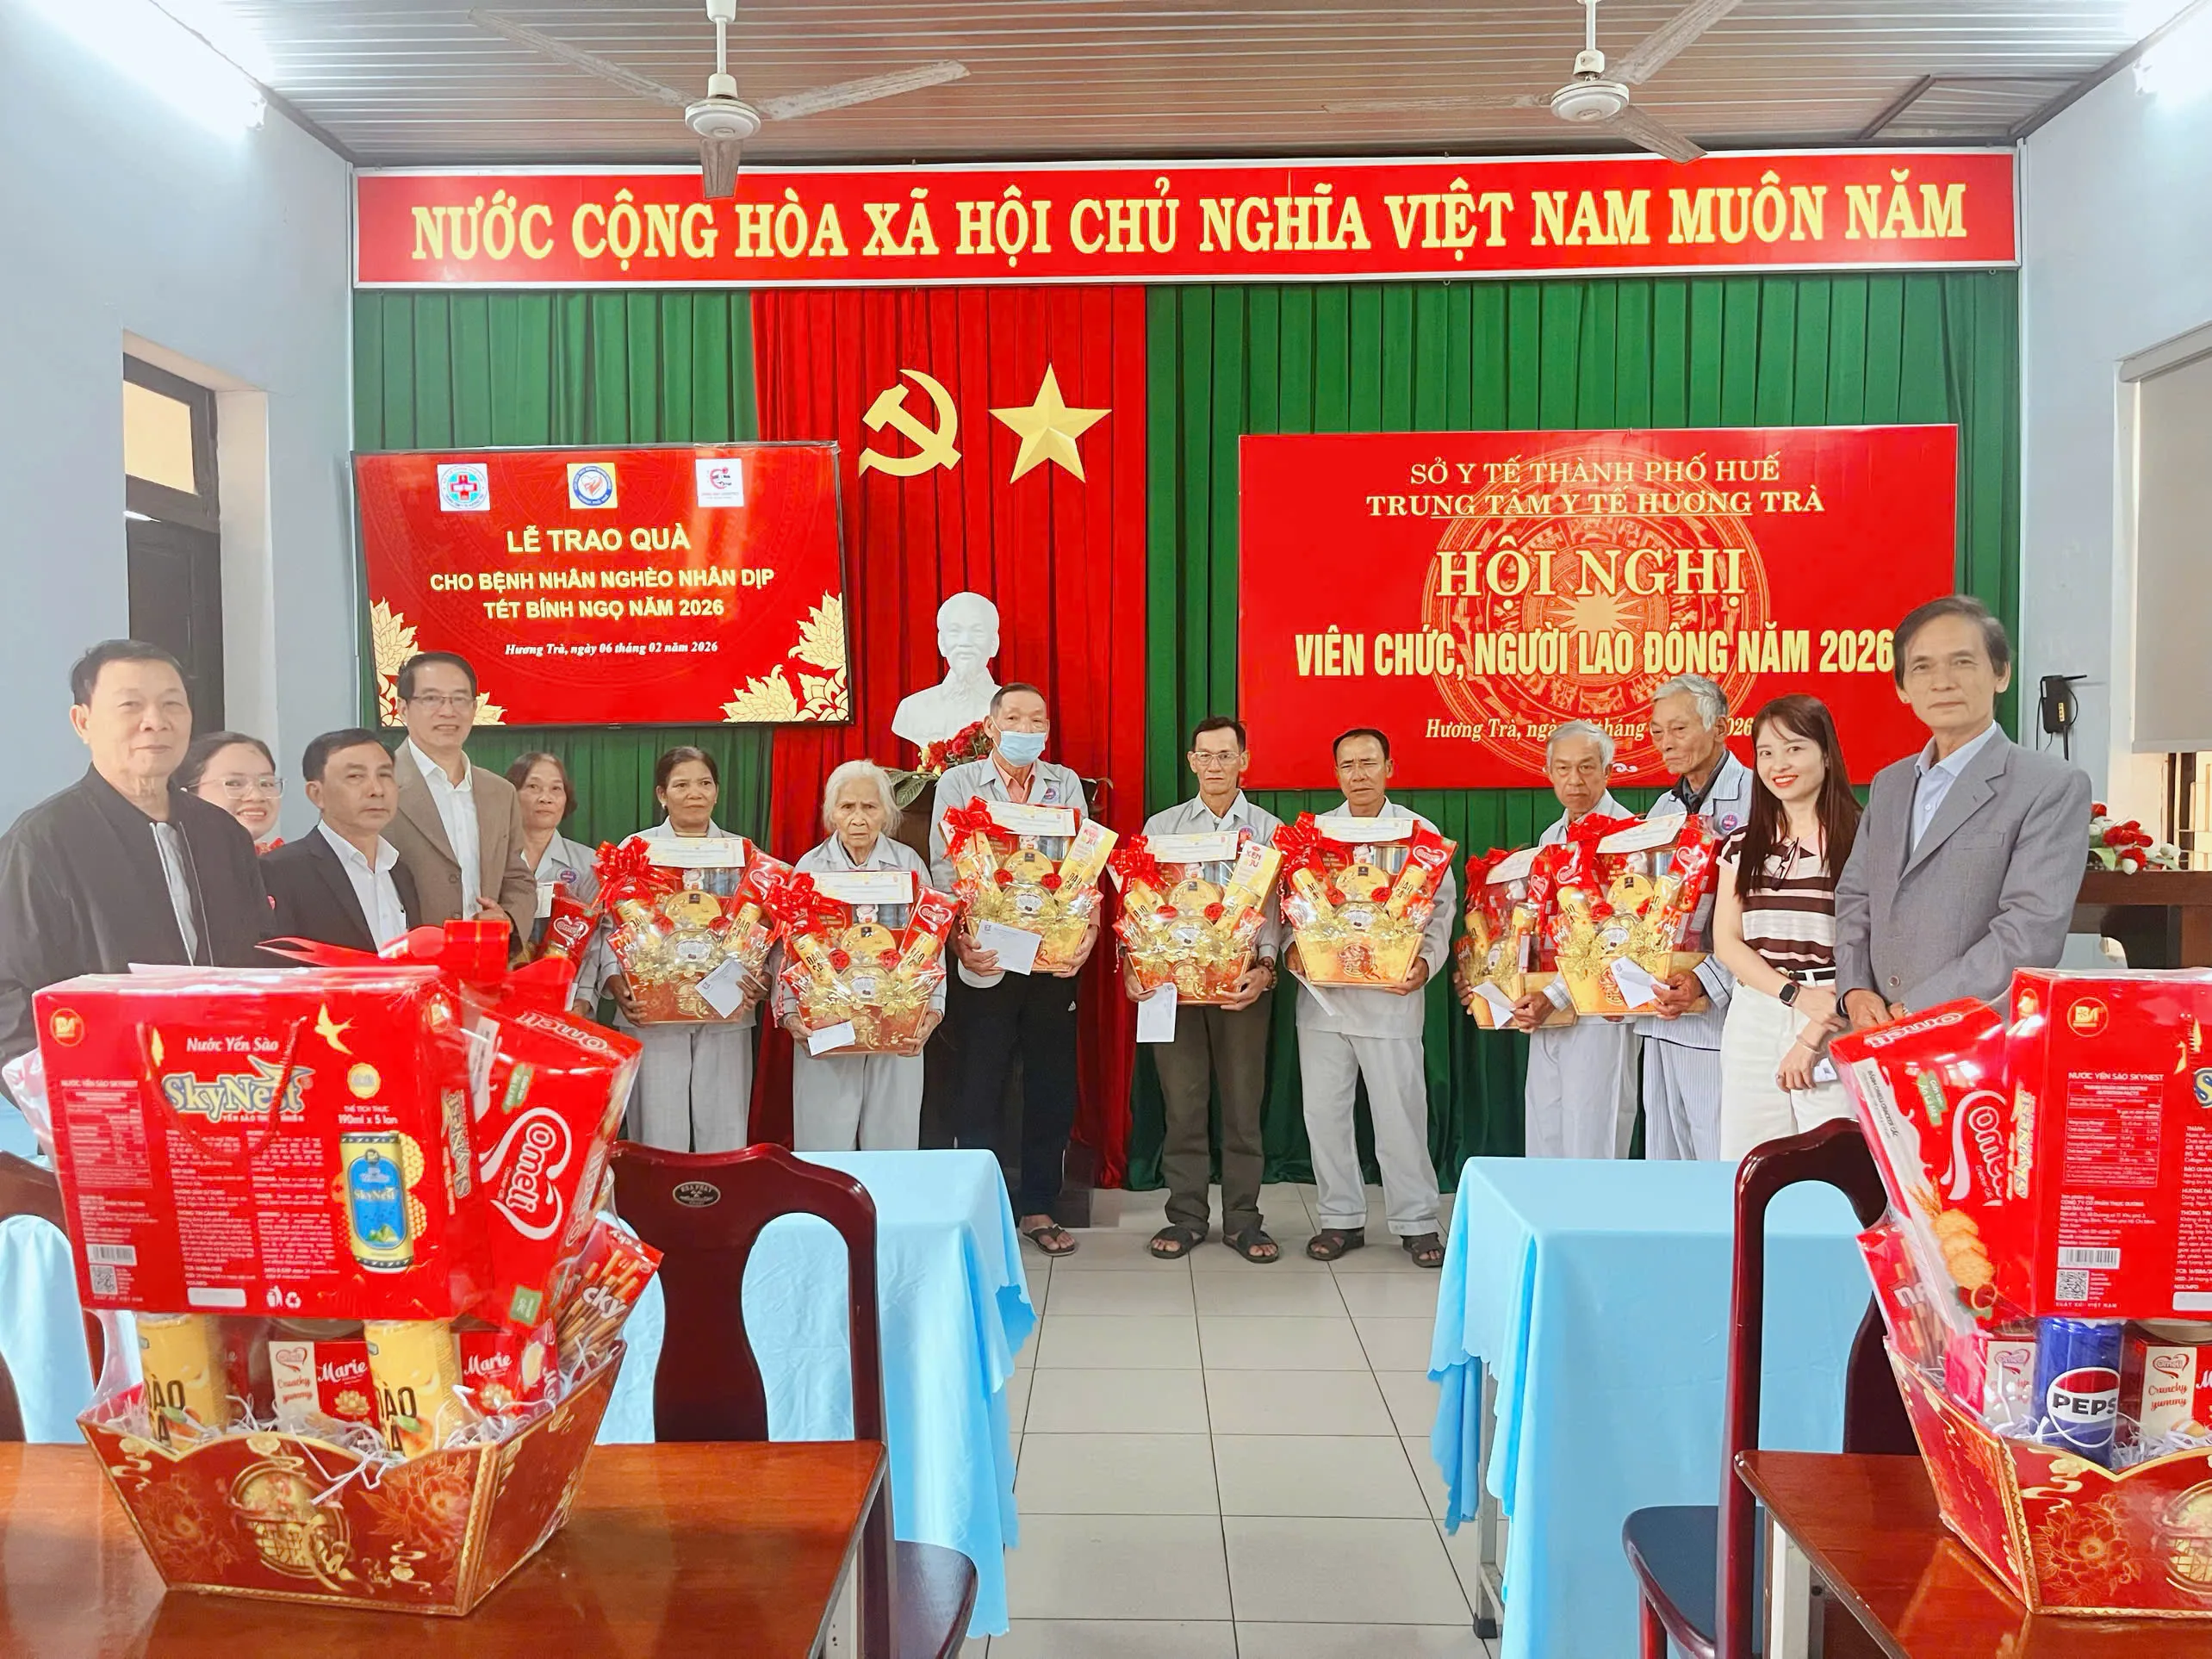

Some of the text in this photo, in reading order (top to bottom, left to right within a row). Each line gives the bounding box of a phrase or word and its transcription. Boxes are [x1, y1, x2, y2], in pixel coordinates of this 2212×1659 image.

[412, 168, 1967, 271] NƯỚC CỘNG HÒA XÃ HỘI CHỦ NGHĨA VIỆT NAM MUÔN NĂM
[1410, 451, 1781, 484] SỞ Y TẾ THÀNH PHỐ HUẾ
[1365, 484, 1824, 516] TRUNG TÂM Y TẾ HƯƠNG TRÀ
[506, 522, 692, 553] LỄ TRAO QUÀ
[431, 565, 775, 593] CHO BỆNH NHÂN NGHÈO NHÂN DỊP
[1435, 535, 1746, 610] HỘI NGHỊ
[525, 597, 575, 619] BÍNH
[579, 600, 624, 621] NGỌ
[629, 596, 674, 618] NĂM
[679, 599, 724, 617] 2026
[506, 641, 718, 657] Hương Trà, ngày 06 tháng 02 năm 2026
[1296, 624, 1364, 676] VIÊN
[1374, 624, 1464, 680] CHỨC,
[1474, 622, 1568, 675] NGƯỜI
[1578, 631, 1634, 674] LAO
[1737, 620, 1810, 673] NĂM
[1818, 629, 1894, 673] 2026
[1426, 718, 1557, 741] Hương Trà, ngà
[186, 1035, 278, 1052] Nước Yến Sào
[506, 1122, 557, 1213] Omeli
[318, 1358, 369, 1383] Marie
[463, 1351, 513, 1376] Marie
[2148, 1382, 2189, 1396] Crunchy
[2150, 1397, 2188, 1412] yummy
